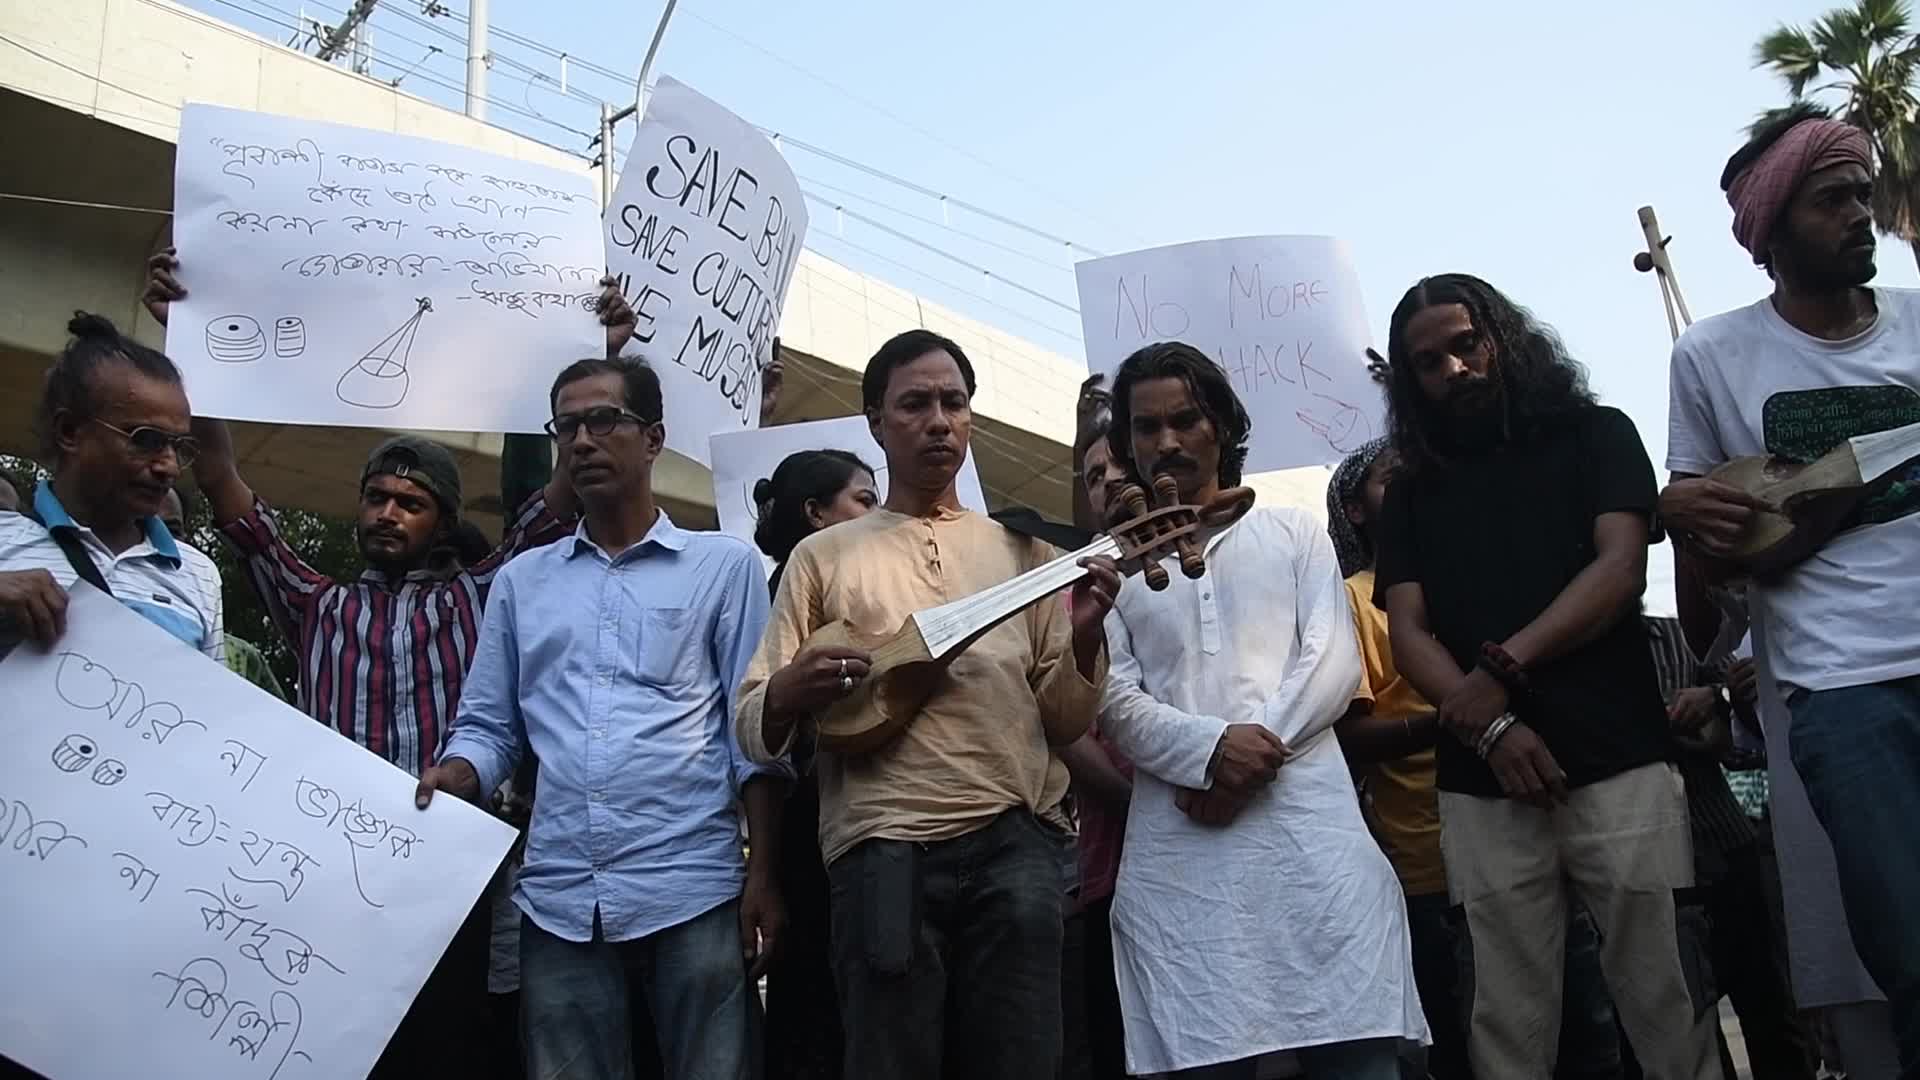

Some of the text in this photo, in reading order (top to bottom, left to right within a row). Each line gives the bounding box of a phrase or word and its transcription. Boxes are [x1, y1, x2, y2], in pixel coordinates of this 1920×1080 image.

[646, 135, 758, 242] SAVE
[611, 203, 689, 275] SAVE
[219, 739, 269, 793] না
[112, 852, 160, 904] না
